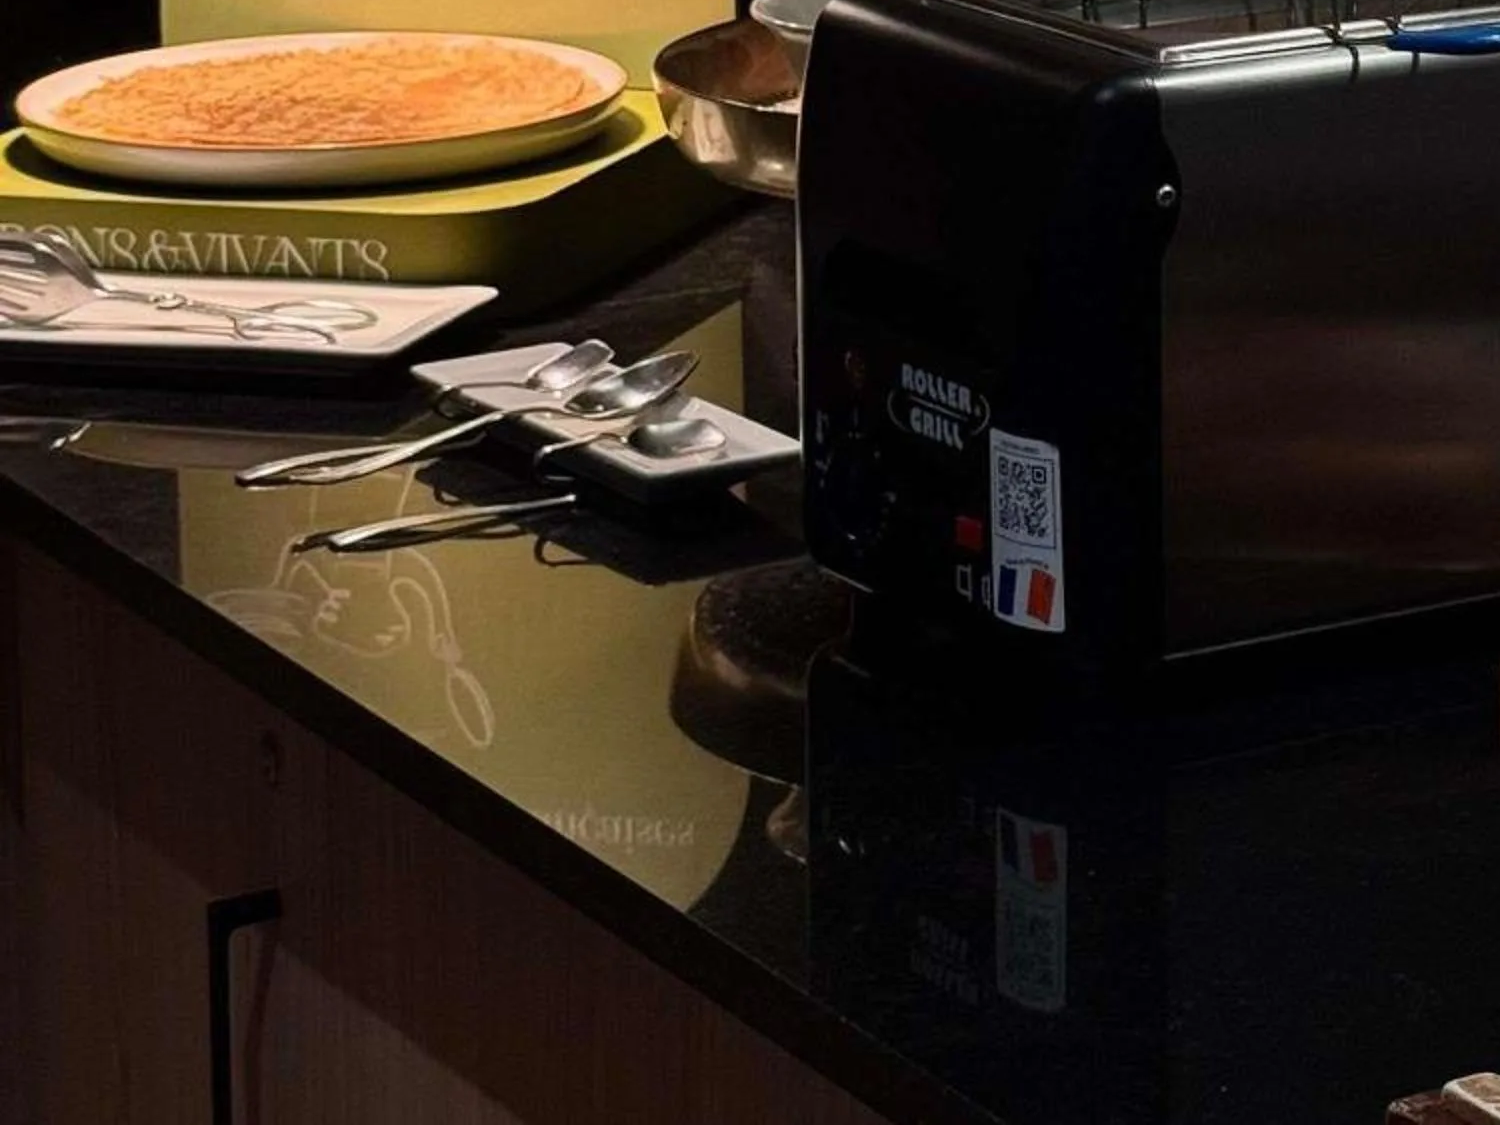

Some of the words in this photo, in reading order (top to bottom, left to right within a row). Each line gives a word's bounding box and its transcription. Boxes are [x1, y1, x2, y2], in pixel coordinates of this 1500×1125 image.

[0, 222, 390, 282] NS&VIVANTS
[901, 363, 973, 416] ROLLER
[909, 405, 964, 451] GRILL
